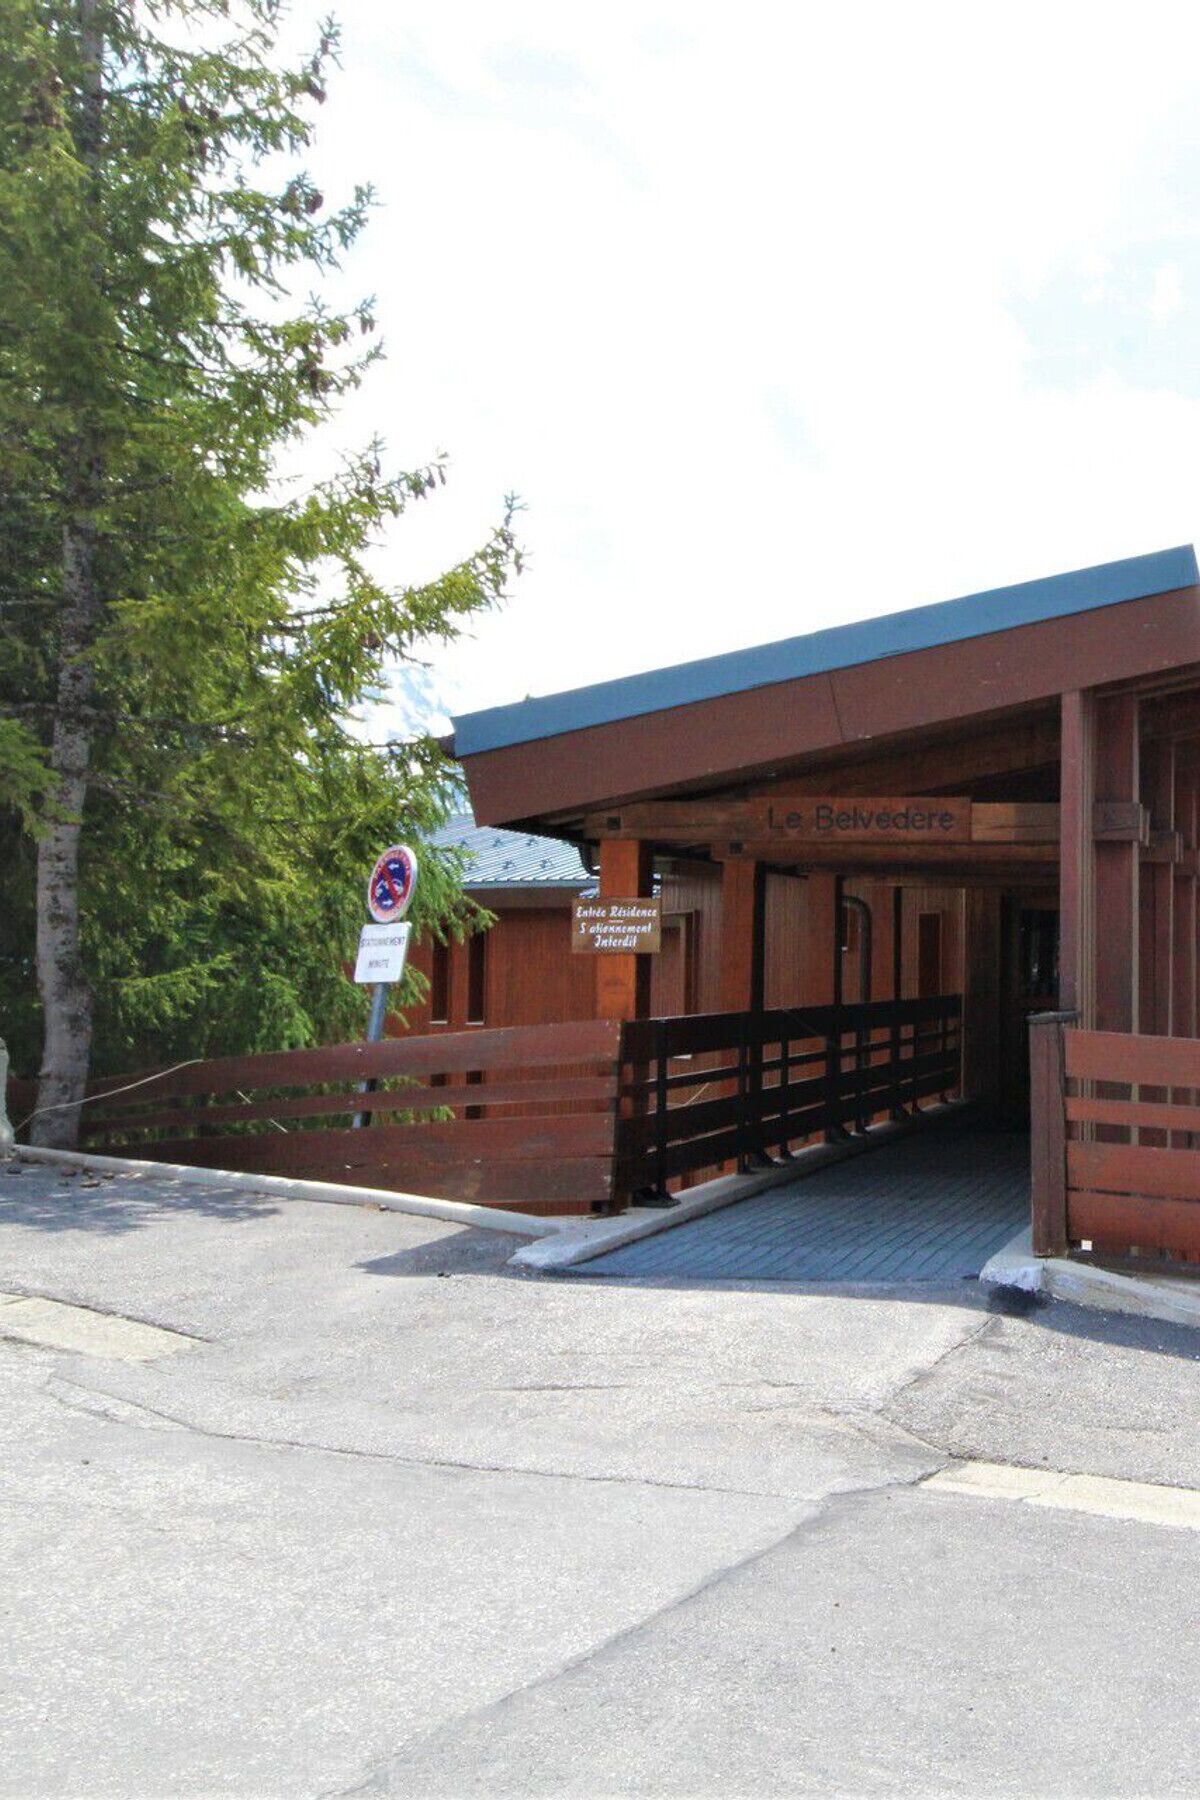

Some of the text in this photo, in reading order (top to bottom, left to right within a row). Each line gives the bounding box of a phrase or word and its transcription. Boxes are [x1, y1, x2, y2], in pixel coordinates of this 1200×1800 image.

[767, 805, 802, 831] Le
[576, 905, 658, 918] Entrée Résidence
[579, 922, 652, 935] Sationnement
[594, 935, 637, 948] Interdit
